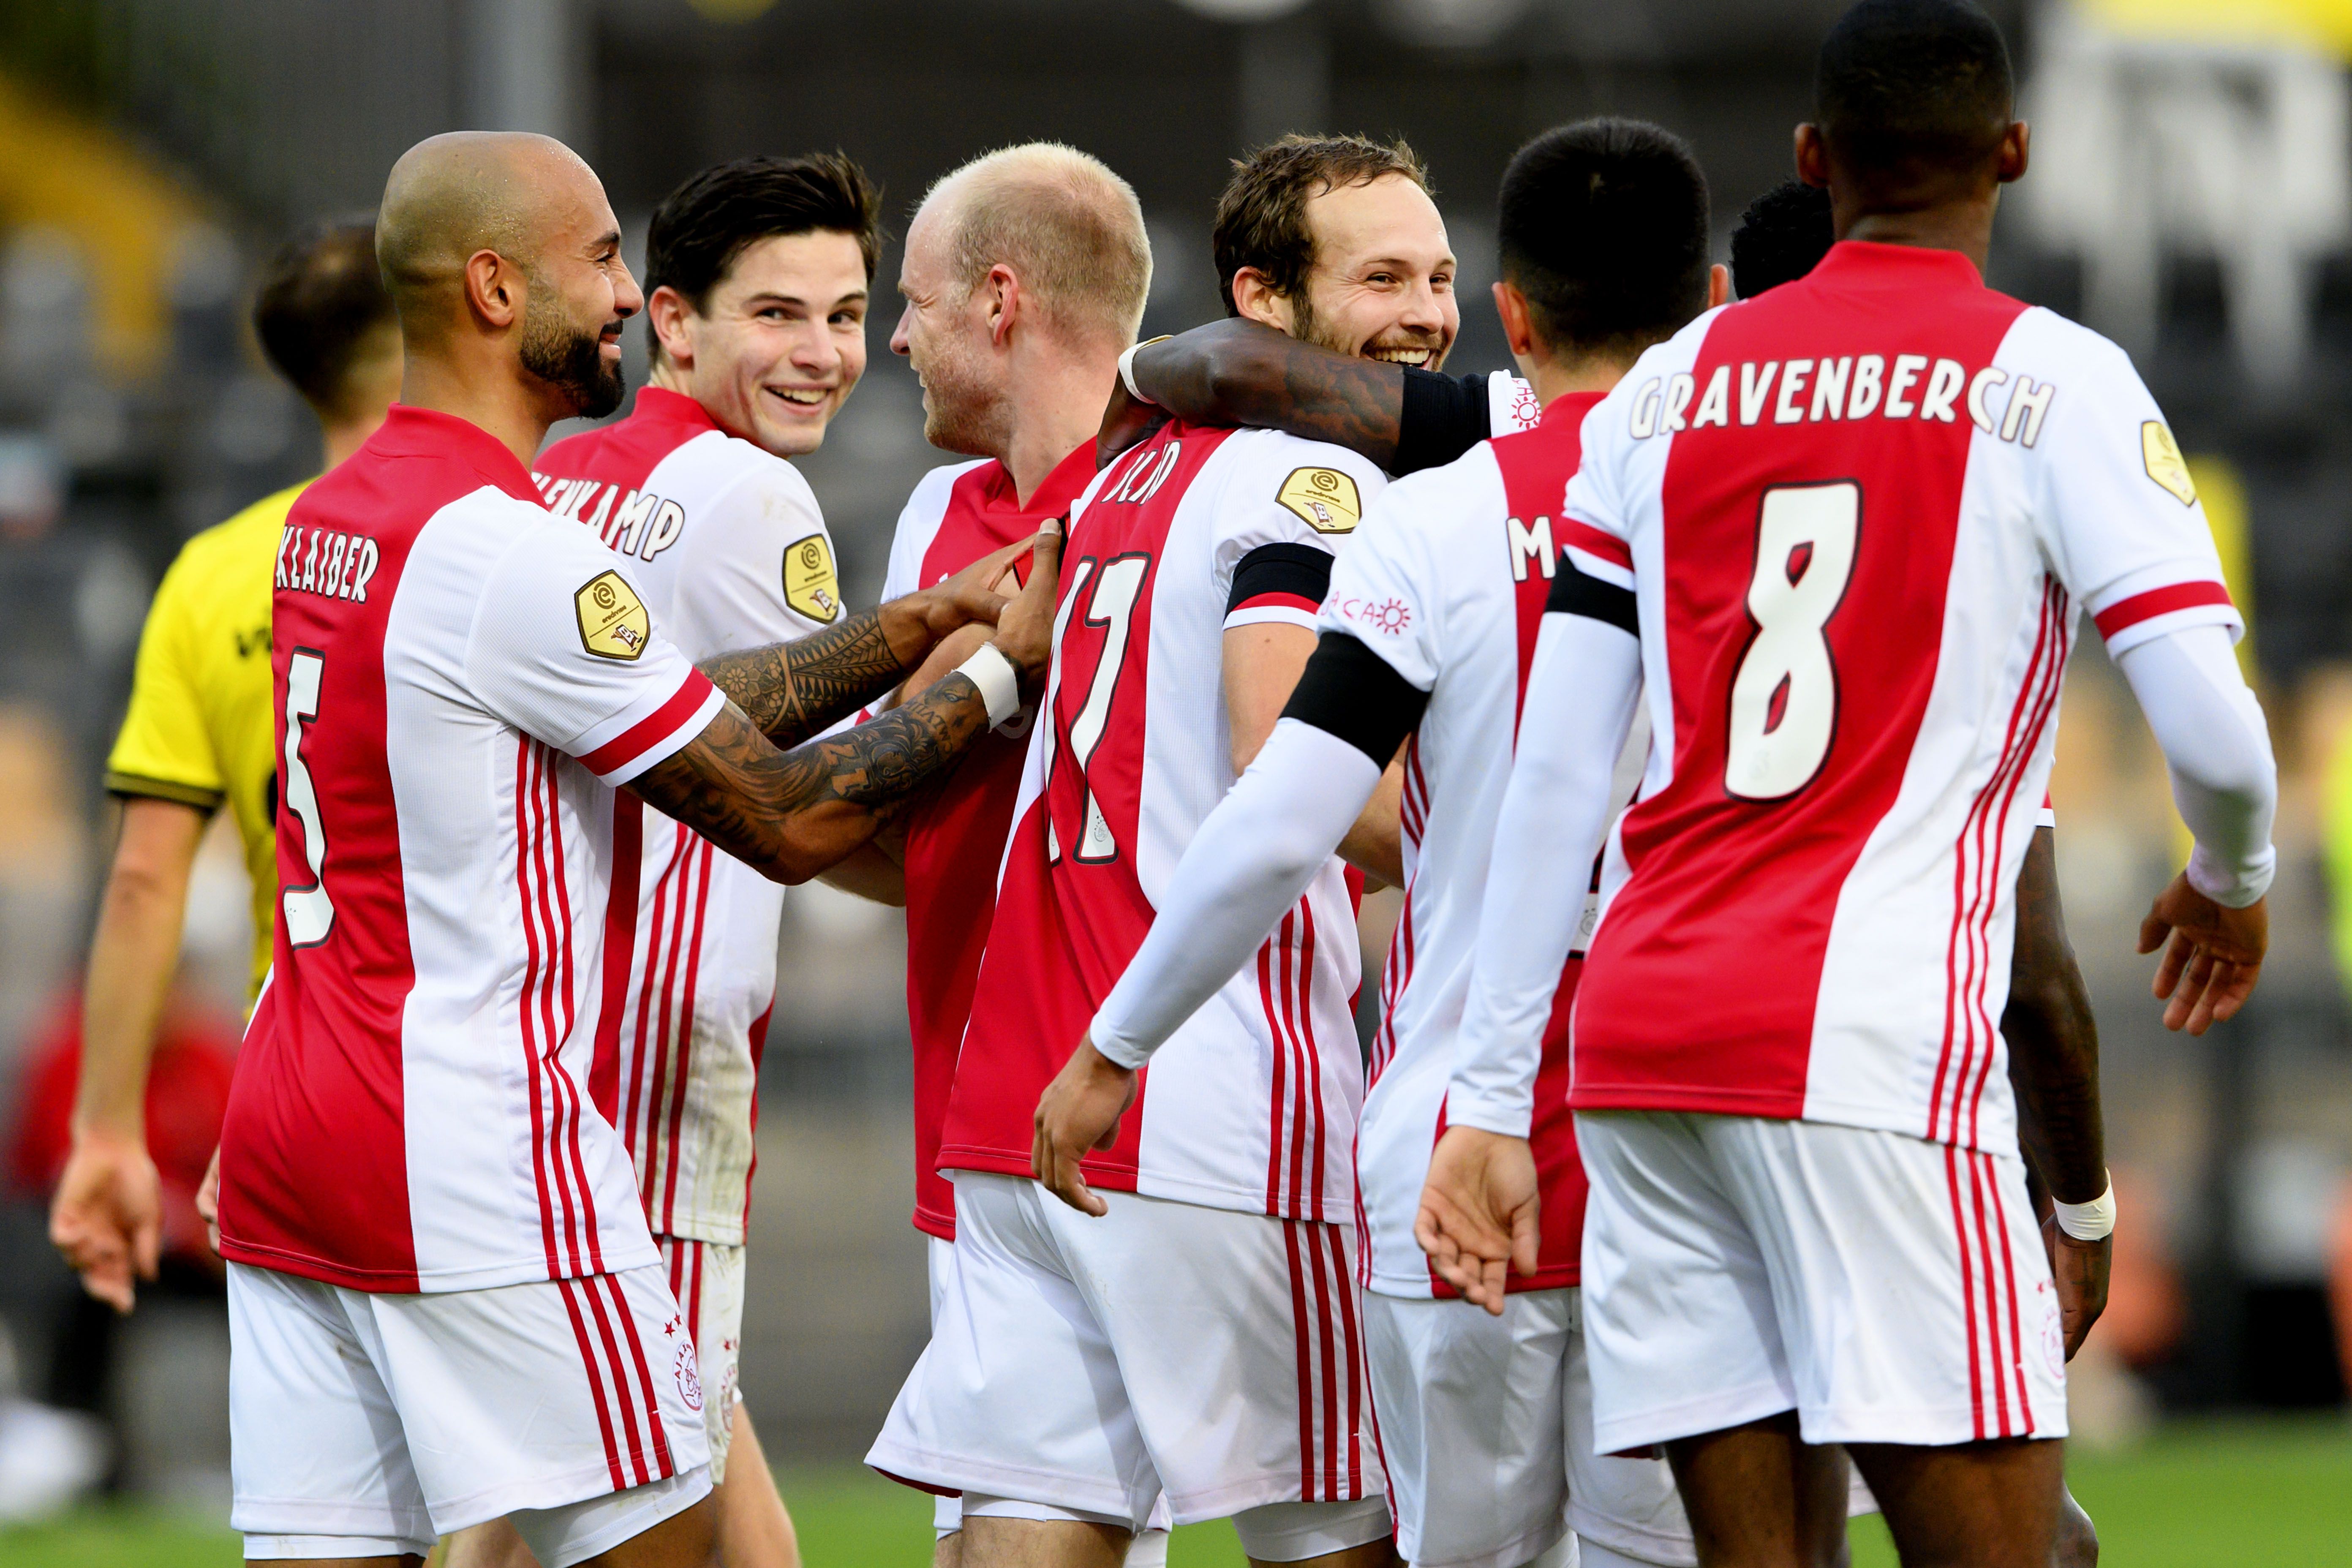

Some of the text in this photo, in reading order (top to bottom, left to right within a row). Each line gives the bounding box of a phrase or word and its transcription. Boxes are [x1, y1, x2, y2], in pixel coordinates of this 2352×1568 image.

[1629, 354, 2056, 450] GRAVENBERCH
[275, 524, 380, 604] KLAIBER
[1044, 552, 1152, 866] 17
[1724, 478, 1864, 803] 8
[282, 645, 337, 950] 5
